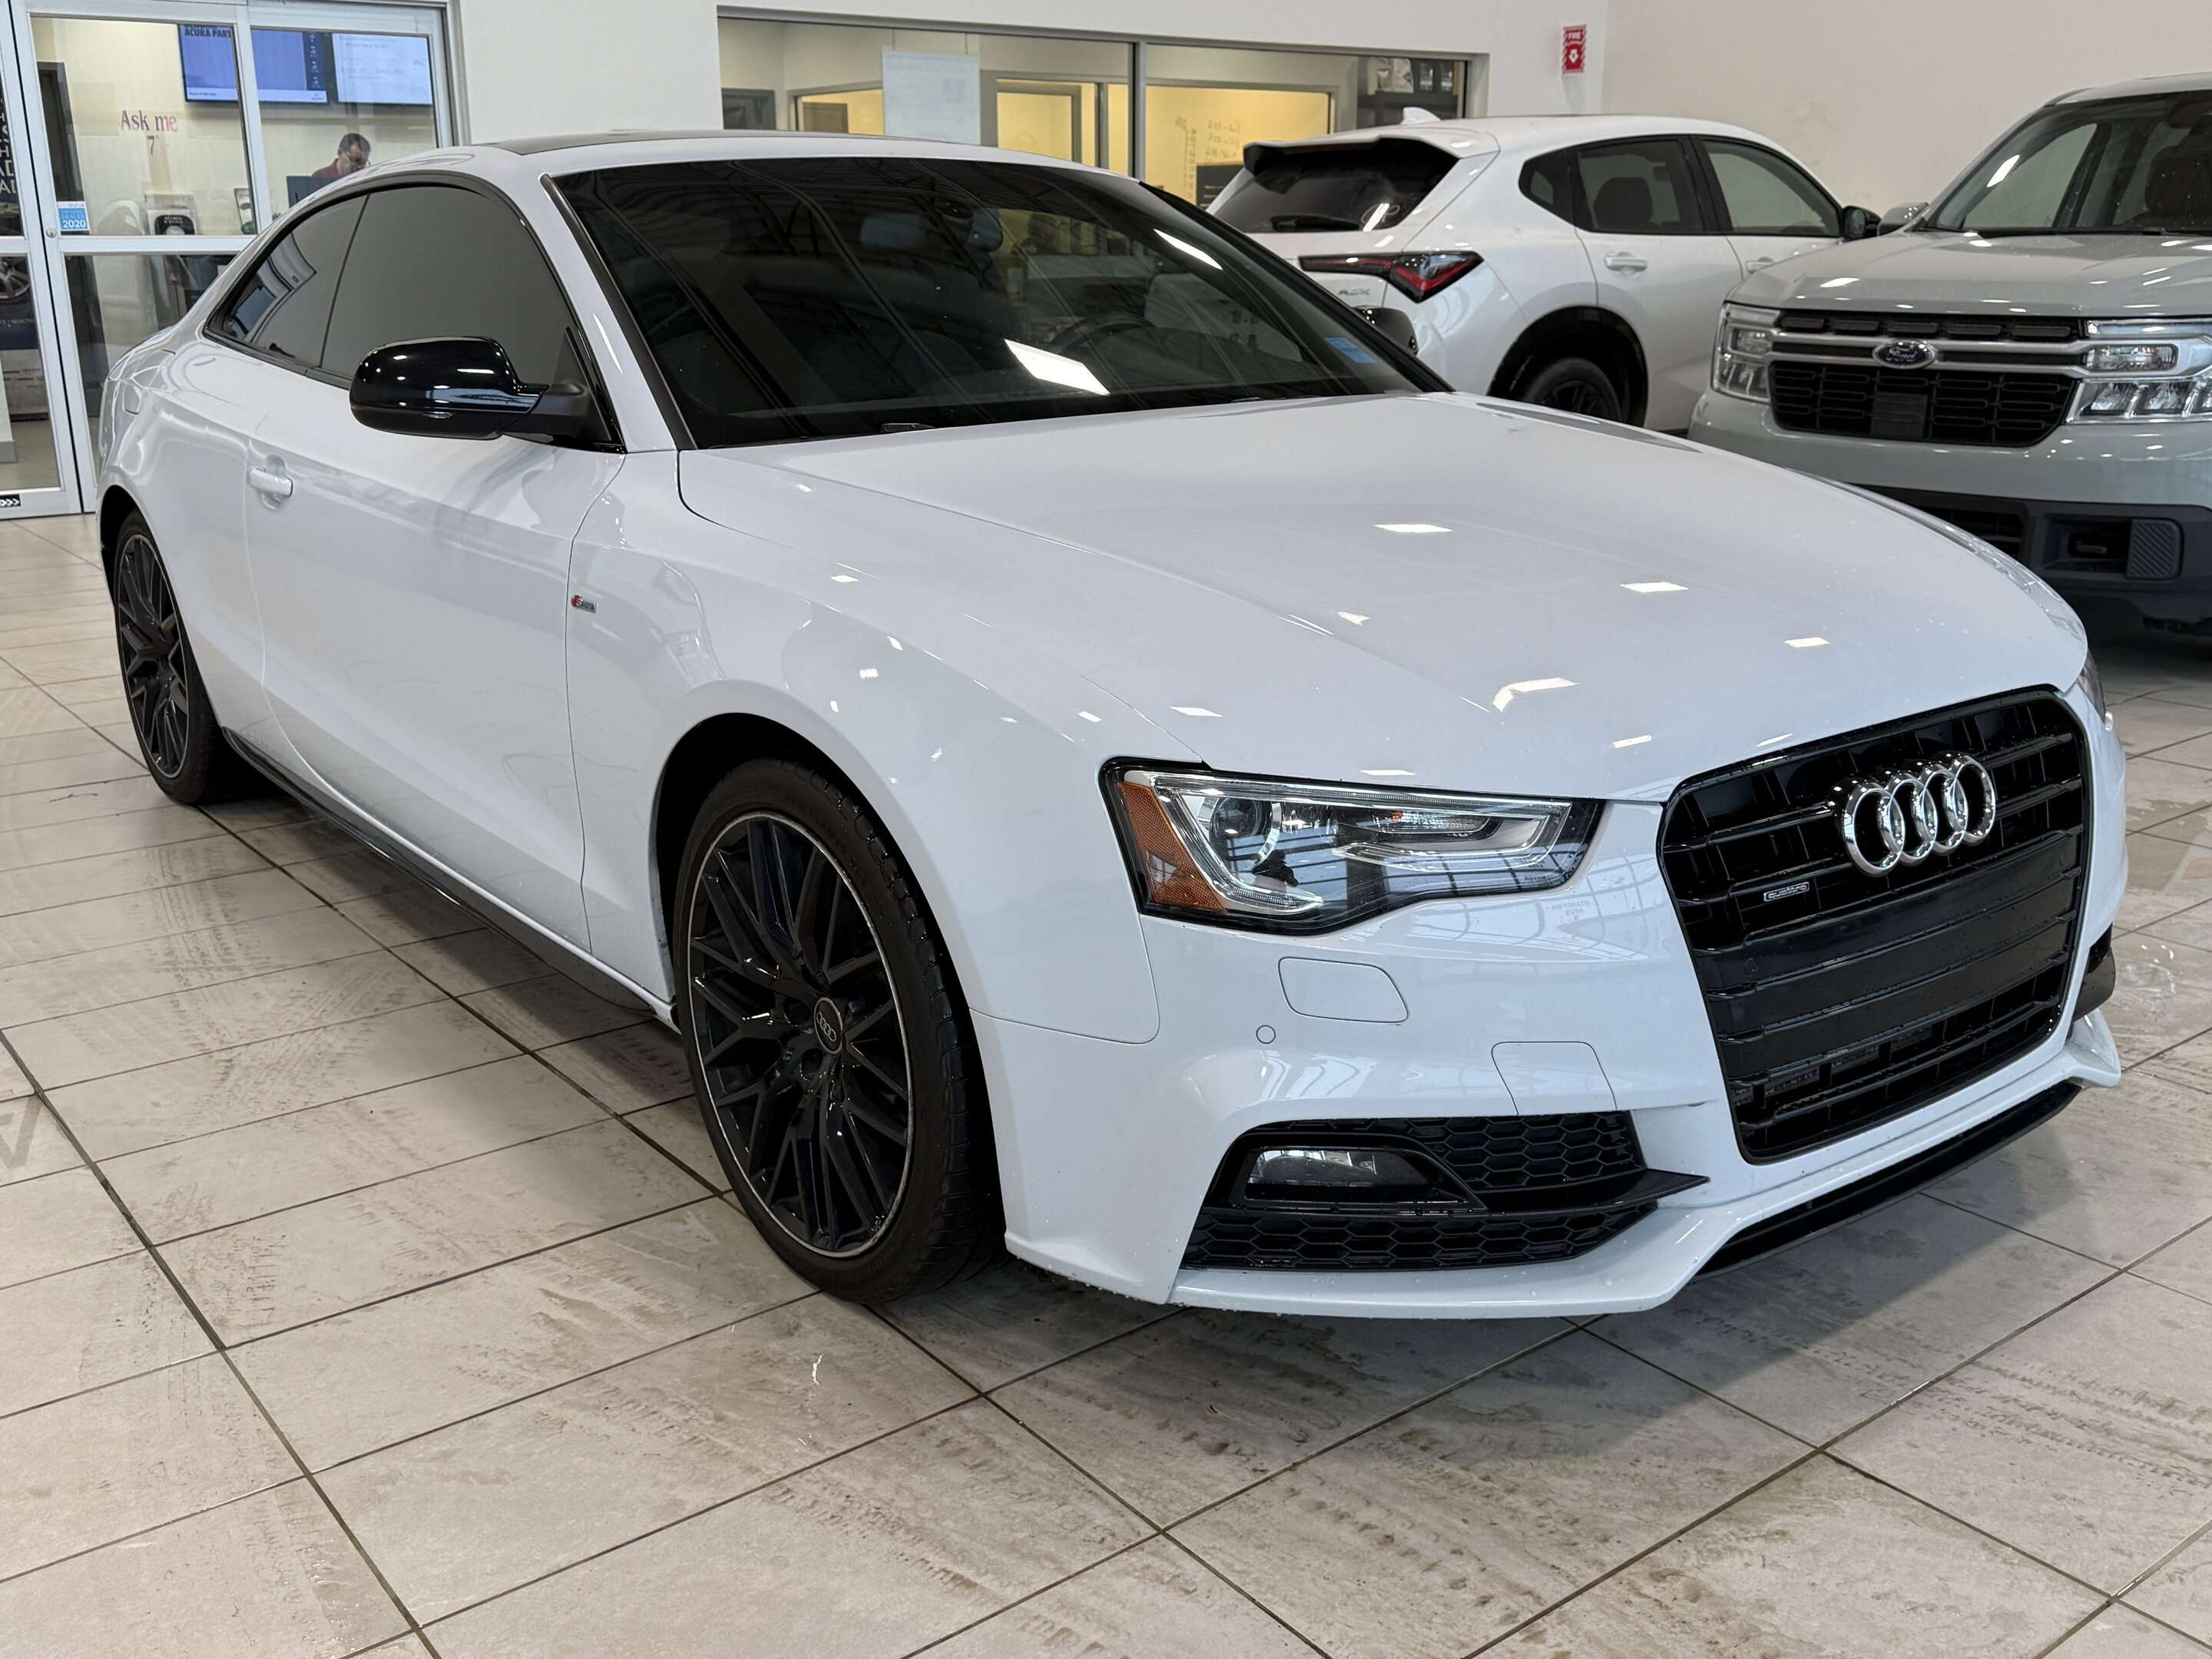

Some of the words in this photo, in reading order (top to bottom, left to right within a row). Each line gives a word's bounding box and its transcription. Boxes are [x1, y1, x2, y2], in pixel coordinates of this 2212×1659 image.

[184, 28, 211, 38] ACURA
[121, 110, 150, 131] Ask
[154, 114, 178, 132] me
[62, 220, 87, 229] 2020
